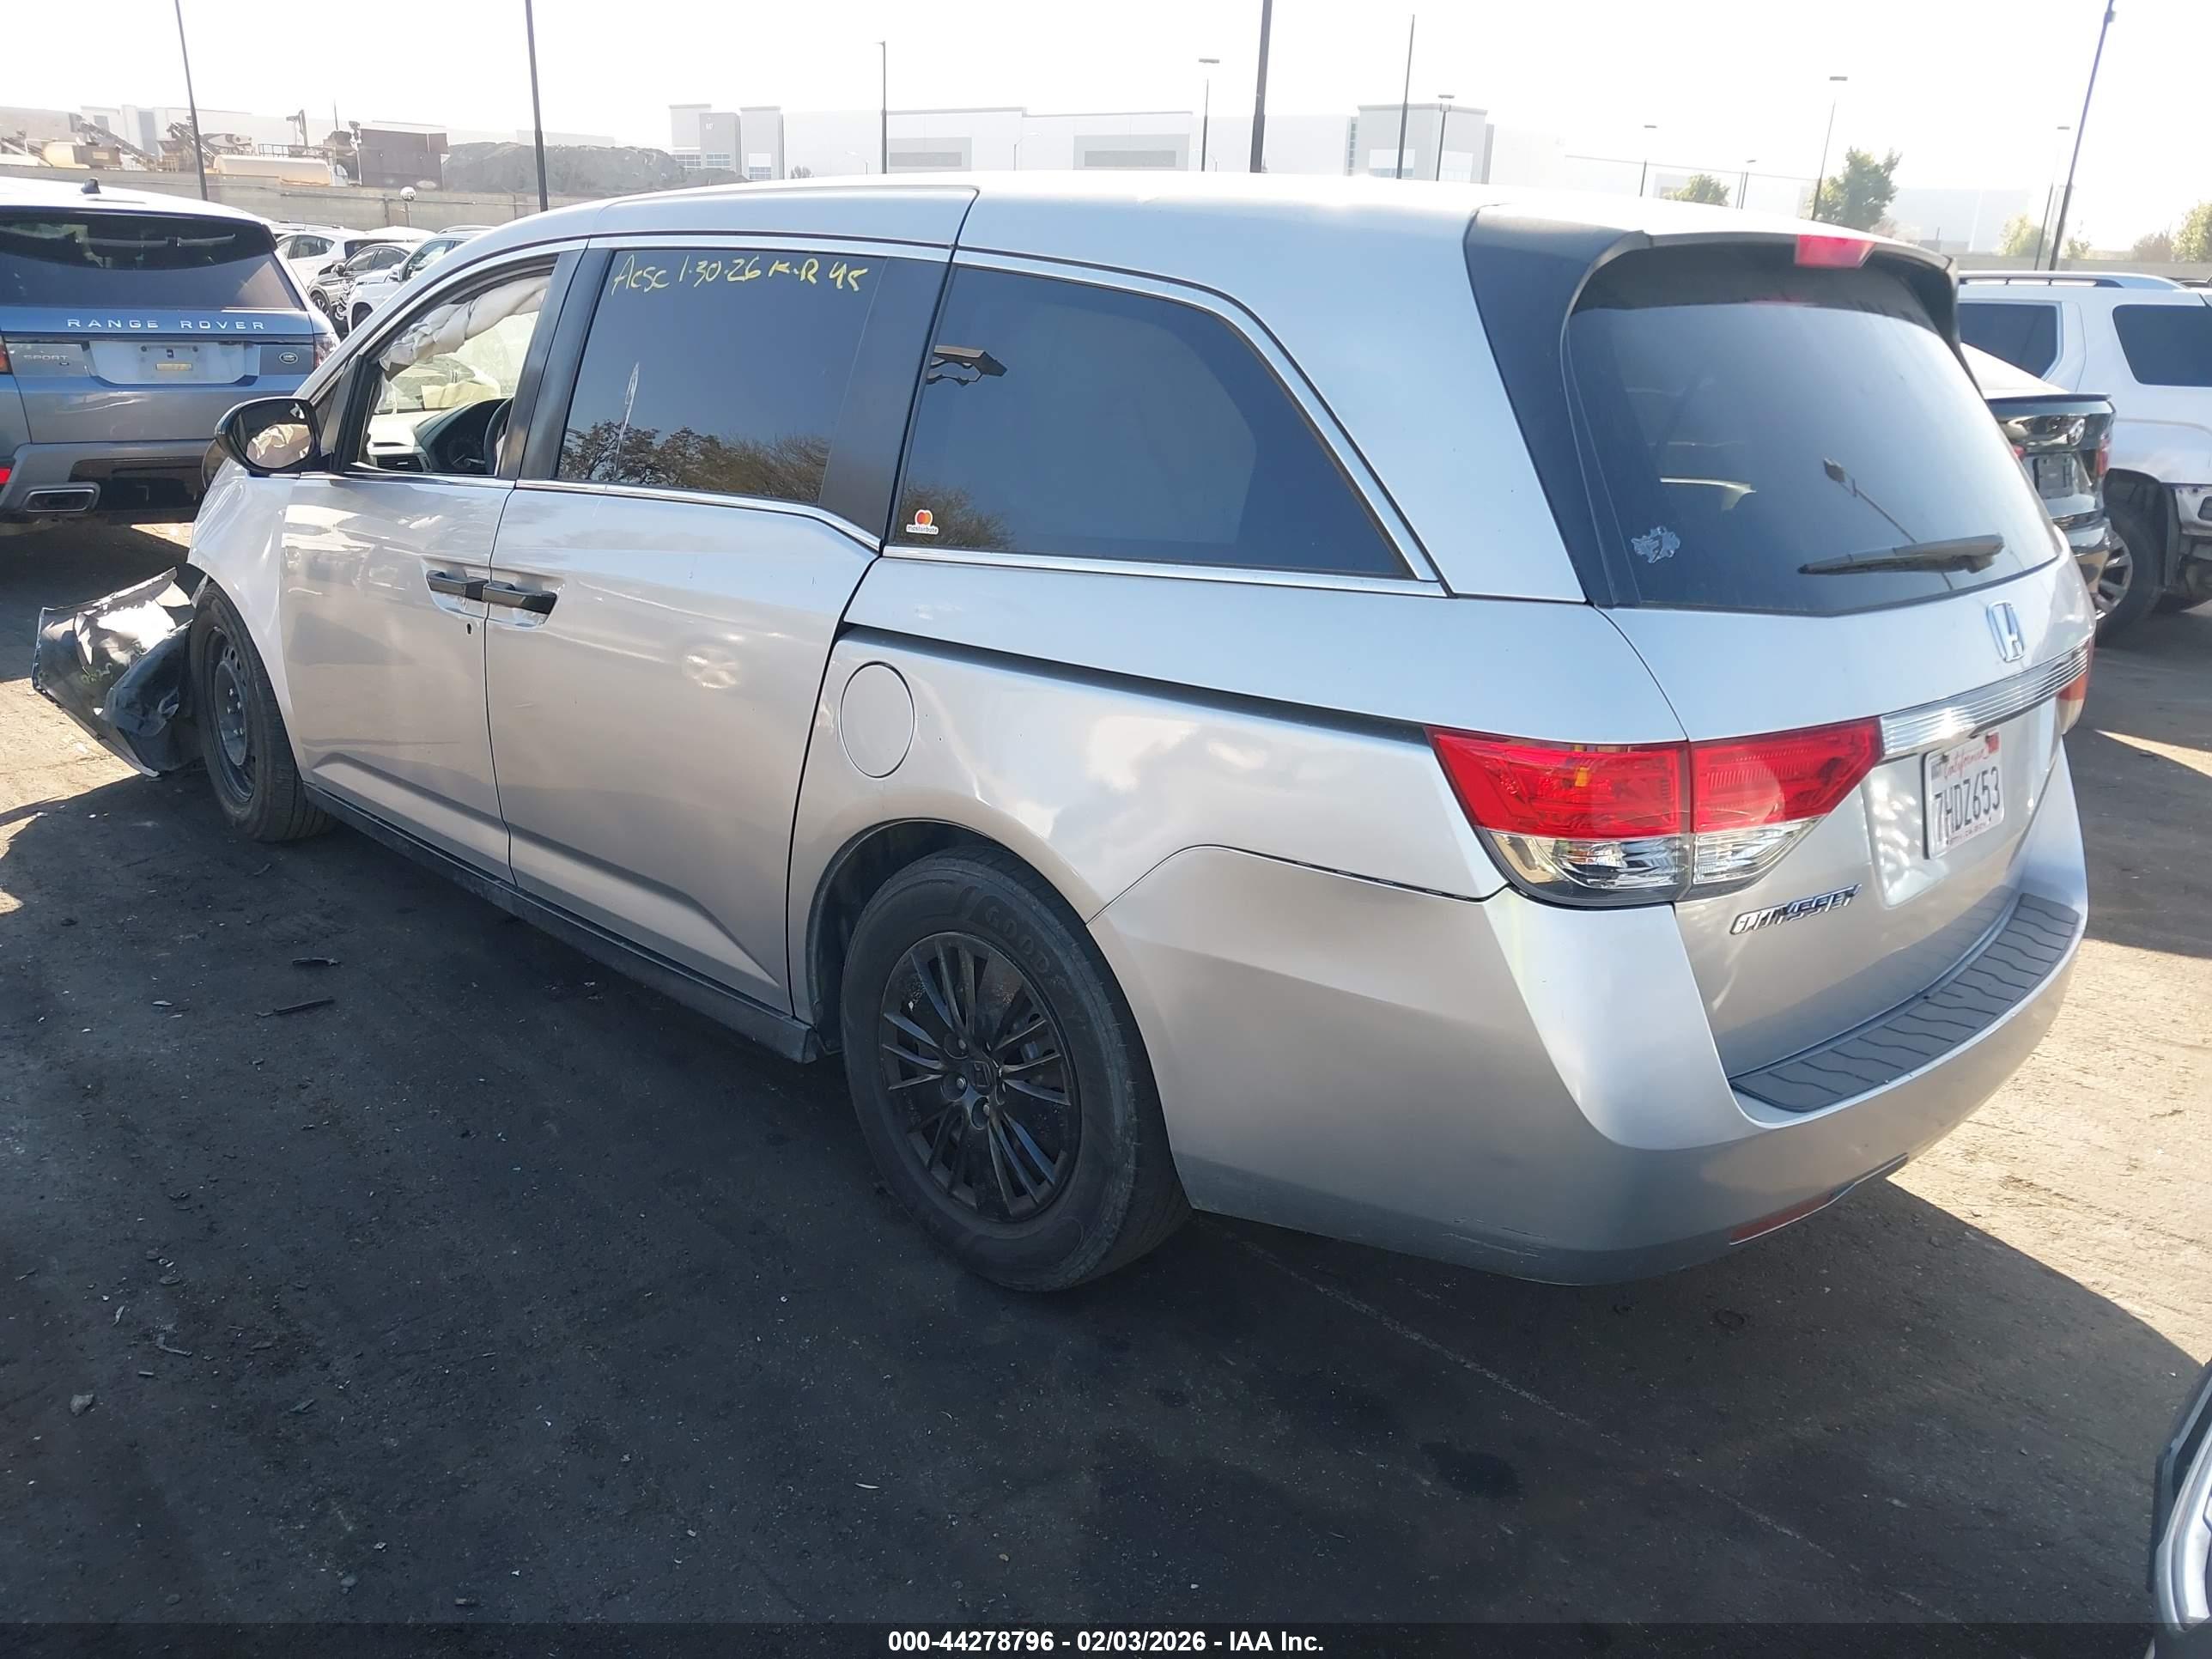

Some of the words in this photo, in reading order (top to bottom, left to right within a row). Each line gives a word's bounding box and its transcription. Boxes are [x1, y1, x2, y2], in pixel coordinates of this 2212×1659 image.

[67, 319, 159, 329] RANGE
[179, 320, 264, 330] ROVER
[1934, 766, 2001, 842] 7HDZ653
